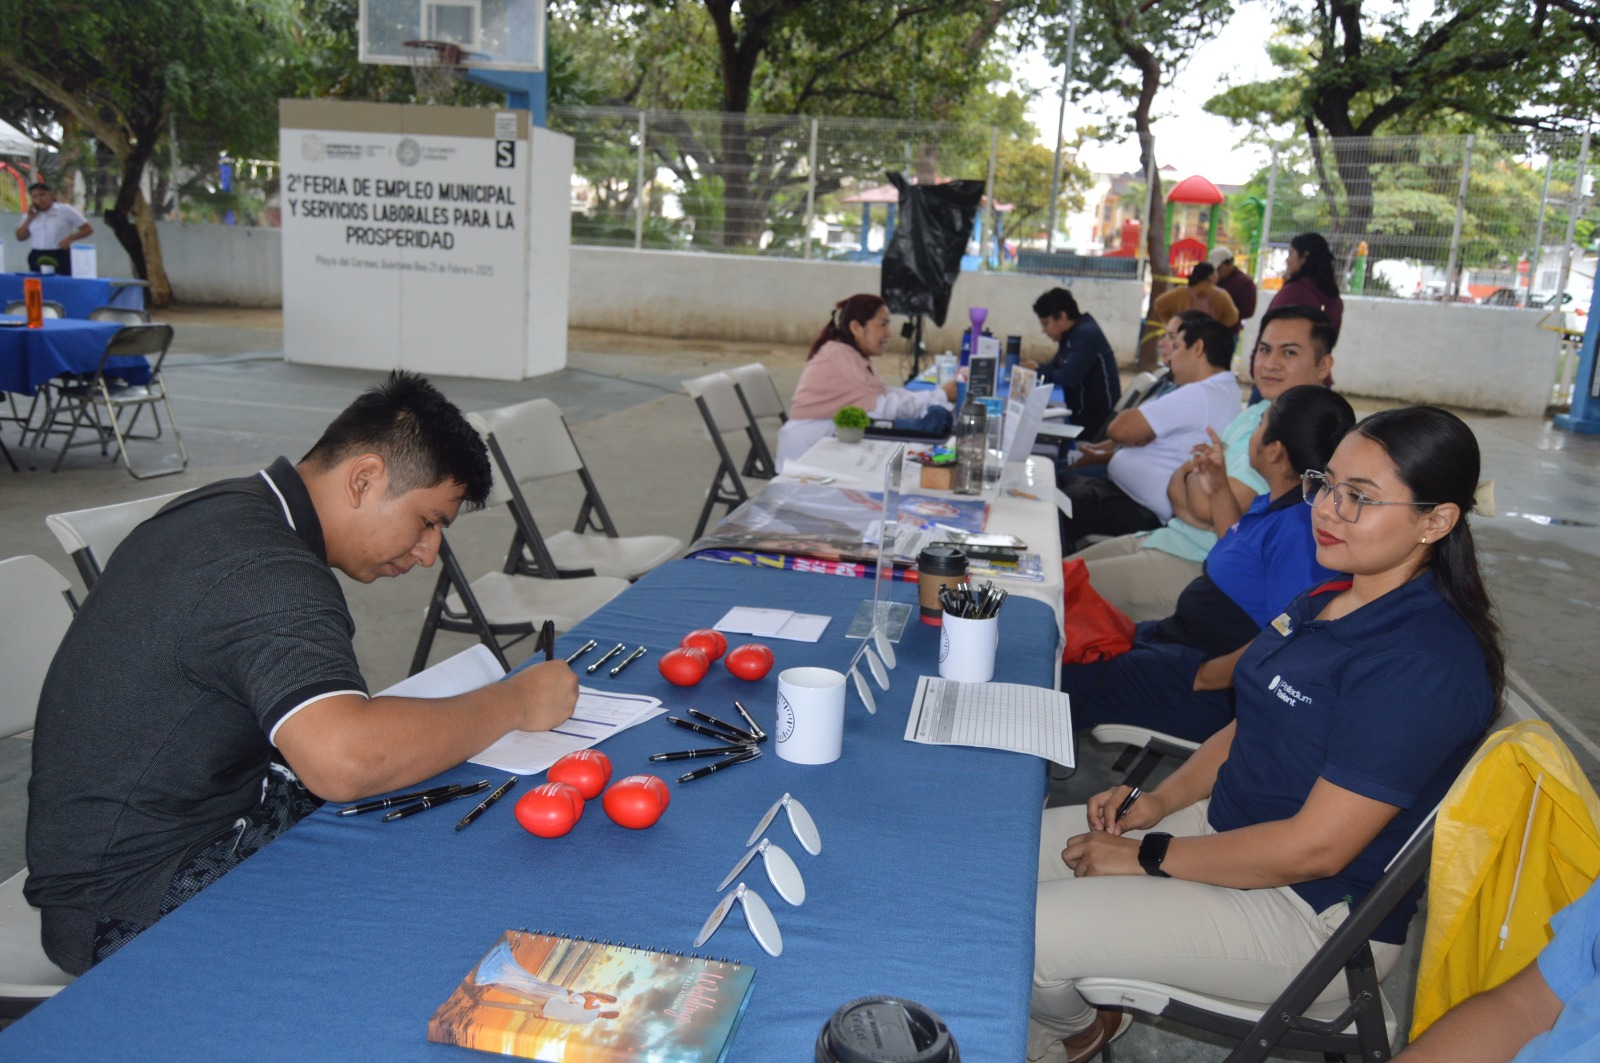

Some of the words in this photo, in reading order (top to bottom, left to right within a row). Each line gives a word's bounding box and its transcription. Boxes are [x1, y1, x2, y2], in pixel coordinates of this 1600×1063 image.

[304, 175, 347, 195] FERIA
[353, 178, 370, 197] DE
[376, 180, 433, 200] EMPLEO
[439, 183, 515, 206] MUNICIPAL
[288, 199, 298, 216] Y
[303, 201, 368, 221] SERVICIOS
[373, 205, 449, 225] LABORALES
[454, 208, 490, 228] PARA
[496, 211, 515, 230] LA
[346, 228, 455, 250] PROSPERIDAD
[1276, 689, 1296, 706] Talent
[1280, 681, 1312, 704] Palladium
[664, 973, 723, 1024] Weddings
